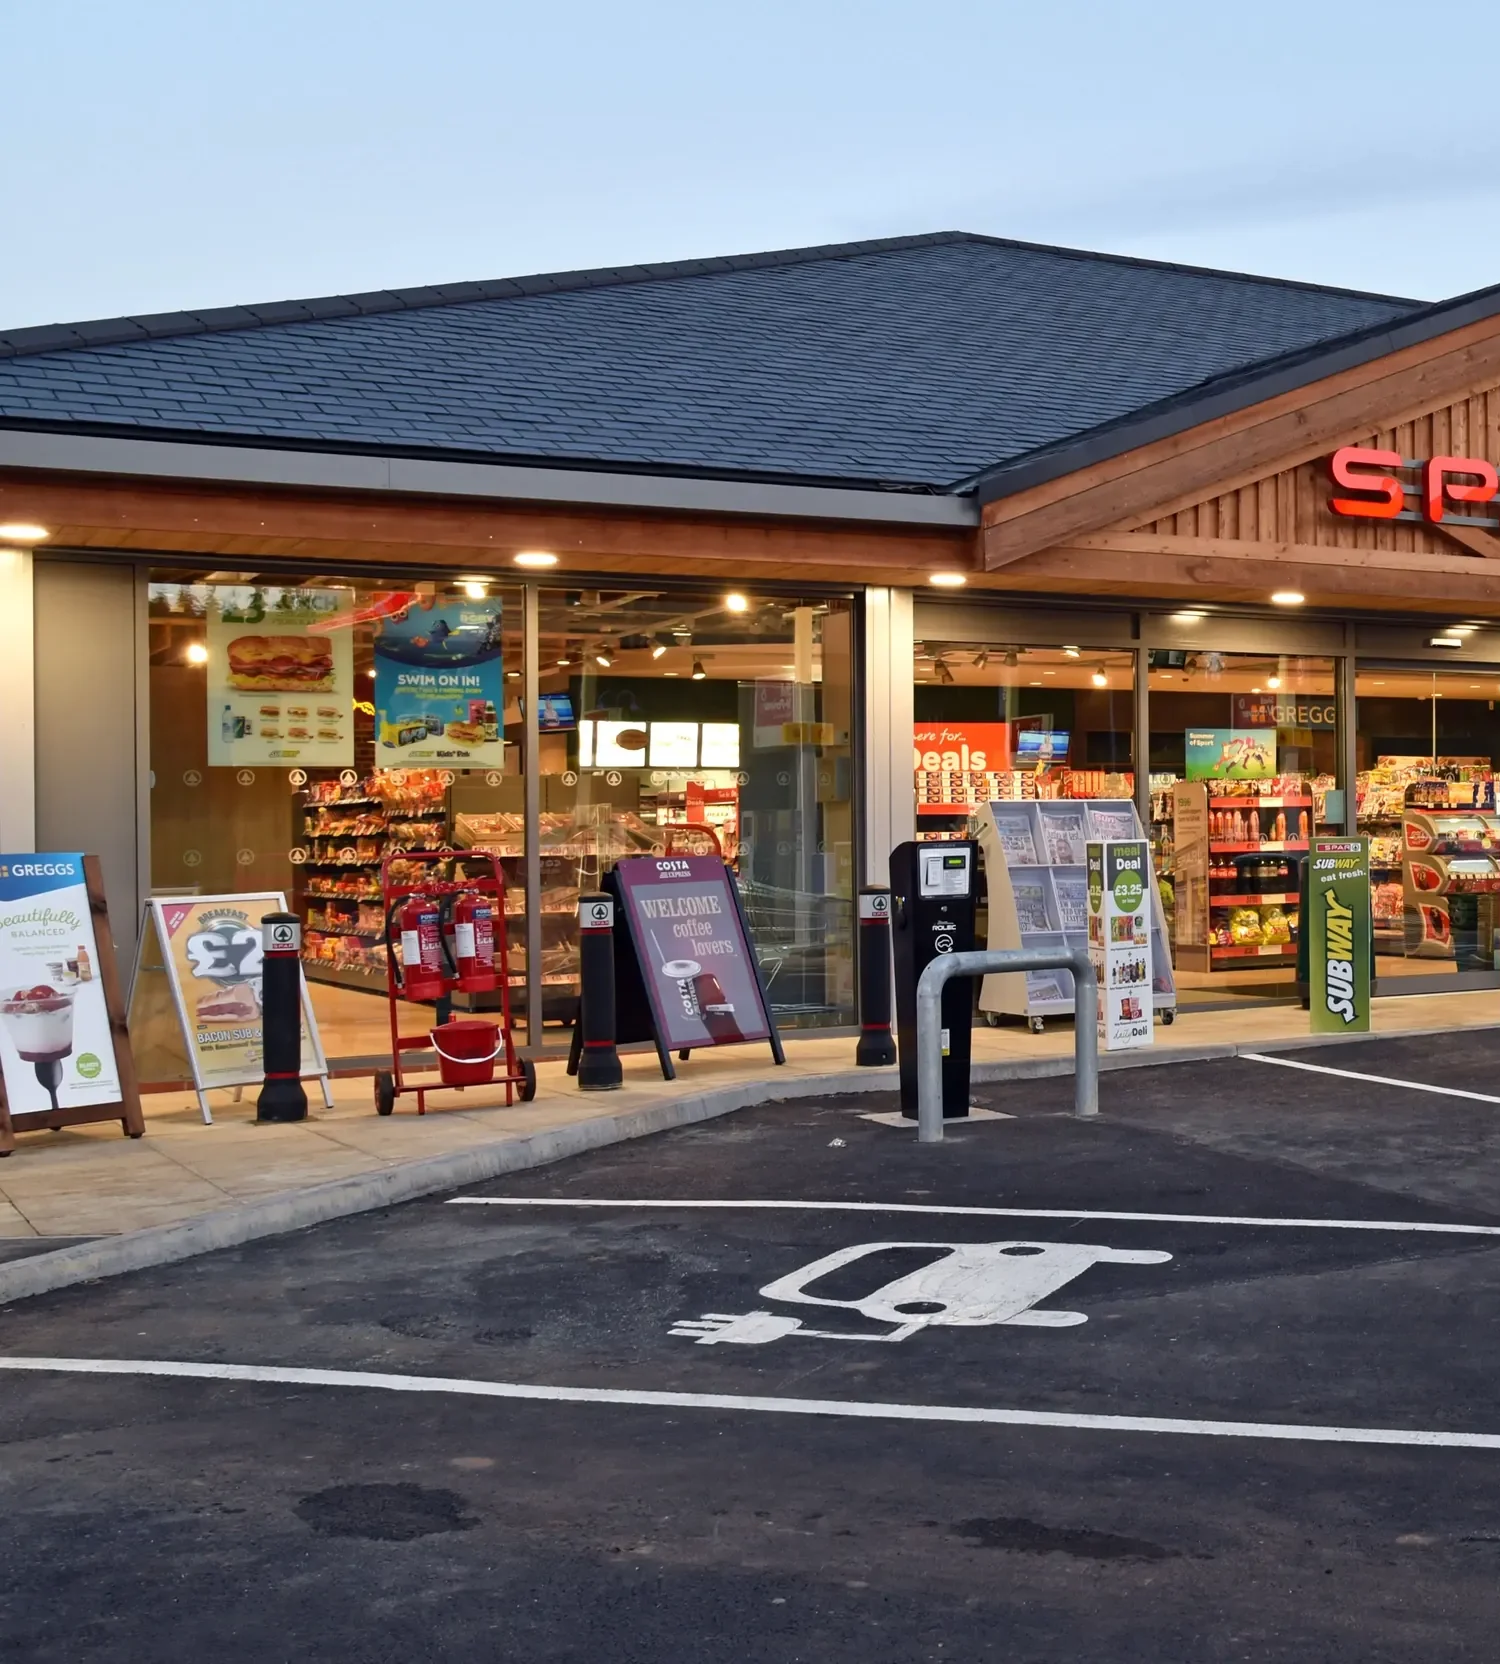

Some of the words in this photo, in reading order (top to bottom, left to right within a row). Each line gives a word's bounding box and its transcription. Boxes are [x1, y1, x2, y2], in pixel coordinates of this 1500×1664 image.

[397, 674, 435, 685] SWIM
[438, 675, 458, 686] ON
[461, 676, 480, 687] IN!
[1271, 705, 1335, 724] GREGG
[914, 732, 936, 741] ere
[1113, 843, 1140, 857] meal
[12, 863, 75, 877] GREGGS
[655, 860, 690, 871] COSTA
[1116, 856, 1141, 870] Deal
[1312, 857, 1361, 870] SUBWAY
[1320, 872, 1337, 883] eat
[1114, 883, 1143, 897] £3.25
[640, 895, 722, 919] WELCOME
[198, 908, 249, 925] BREAKFAST
[11, 928, 66, 938] BALANCED
[673, 918, 713, 938] coffee
[691, 939, 734, 957] lovers
[1324, 889, 1358, 1024] SUBWAY
[676, 978, 694, 1016] COSTA
[196, 1027, 232, 1045] BACON
[233, 1027, 253, 1040] SUB
[1132, 1026, 1148, 1037] Deli
